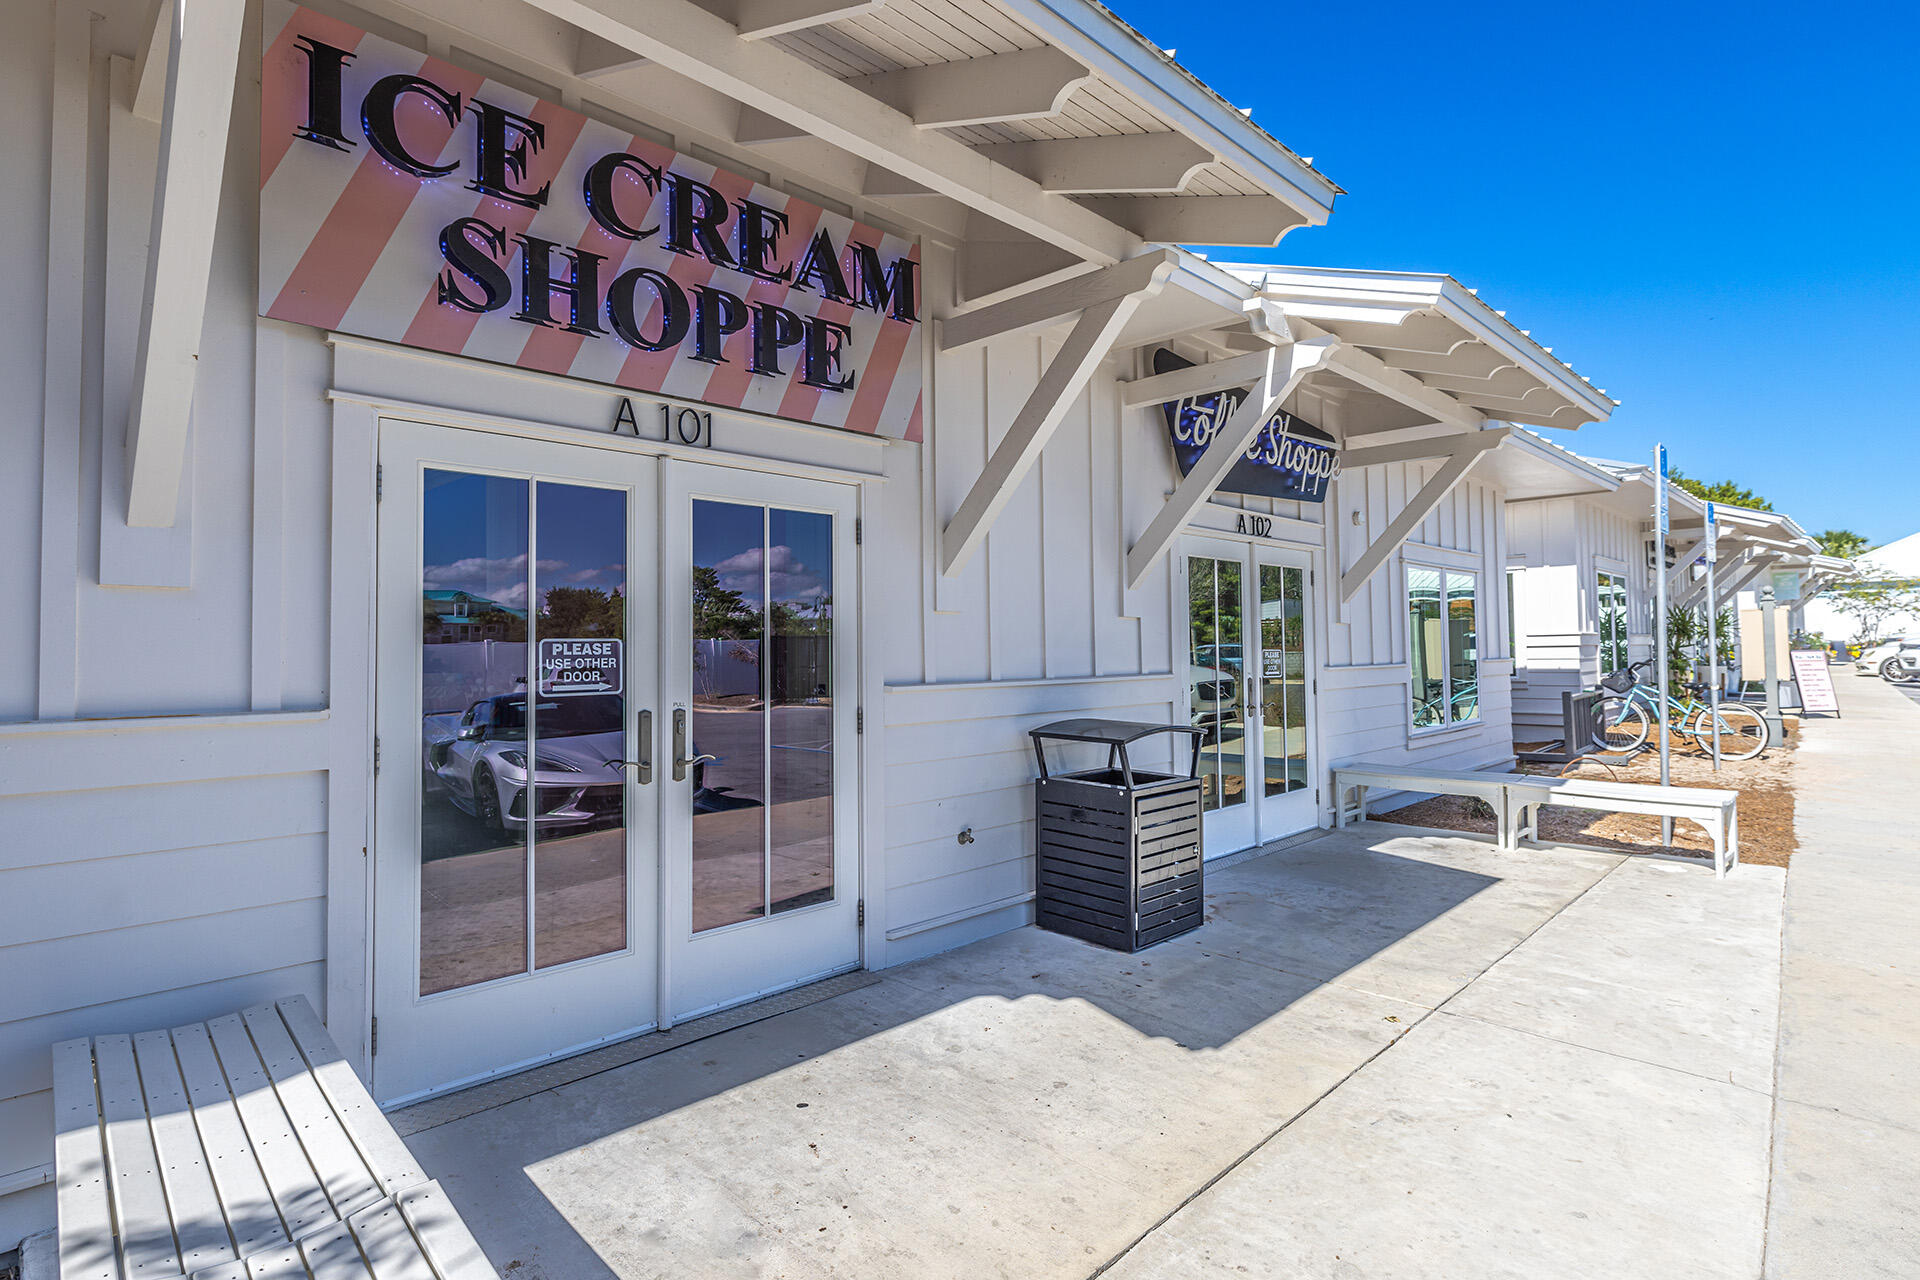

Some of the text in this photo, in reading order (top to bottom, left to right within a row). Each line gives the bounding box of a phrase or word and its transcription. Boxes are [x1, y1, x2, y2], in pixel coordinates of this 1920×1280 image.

[293, 34, 922, 325] ICE CREAM
[437, 217, 855, 393] SHOPPE
[613, 397, 712, 449] A 101
[1266, 414, 1342, 496] Shoppe
[1237, 514, 1273, 538] A 102
[546, 657, 617, 670] USE OTHER
[552, 642, 612, 656] PLEASE
[563, 671, 601, 683] DOOR
